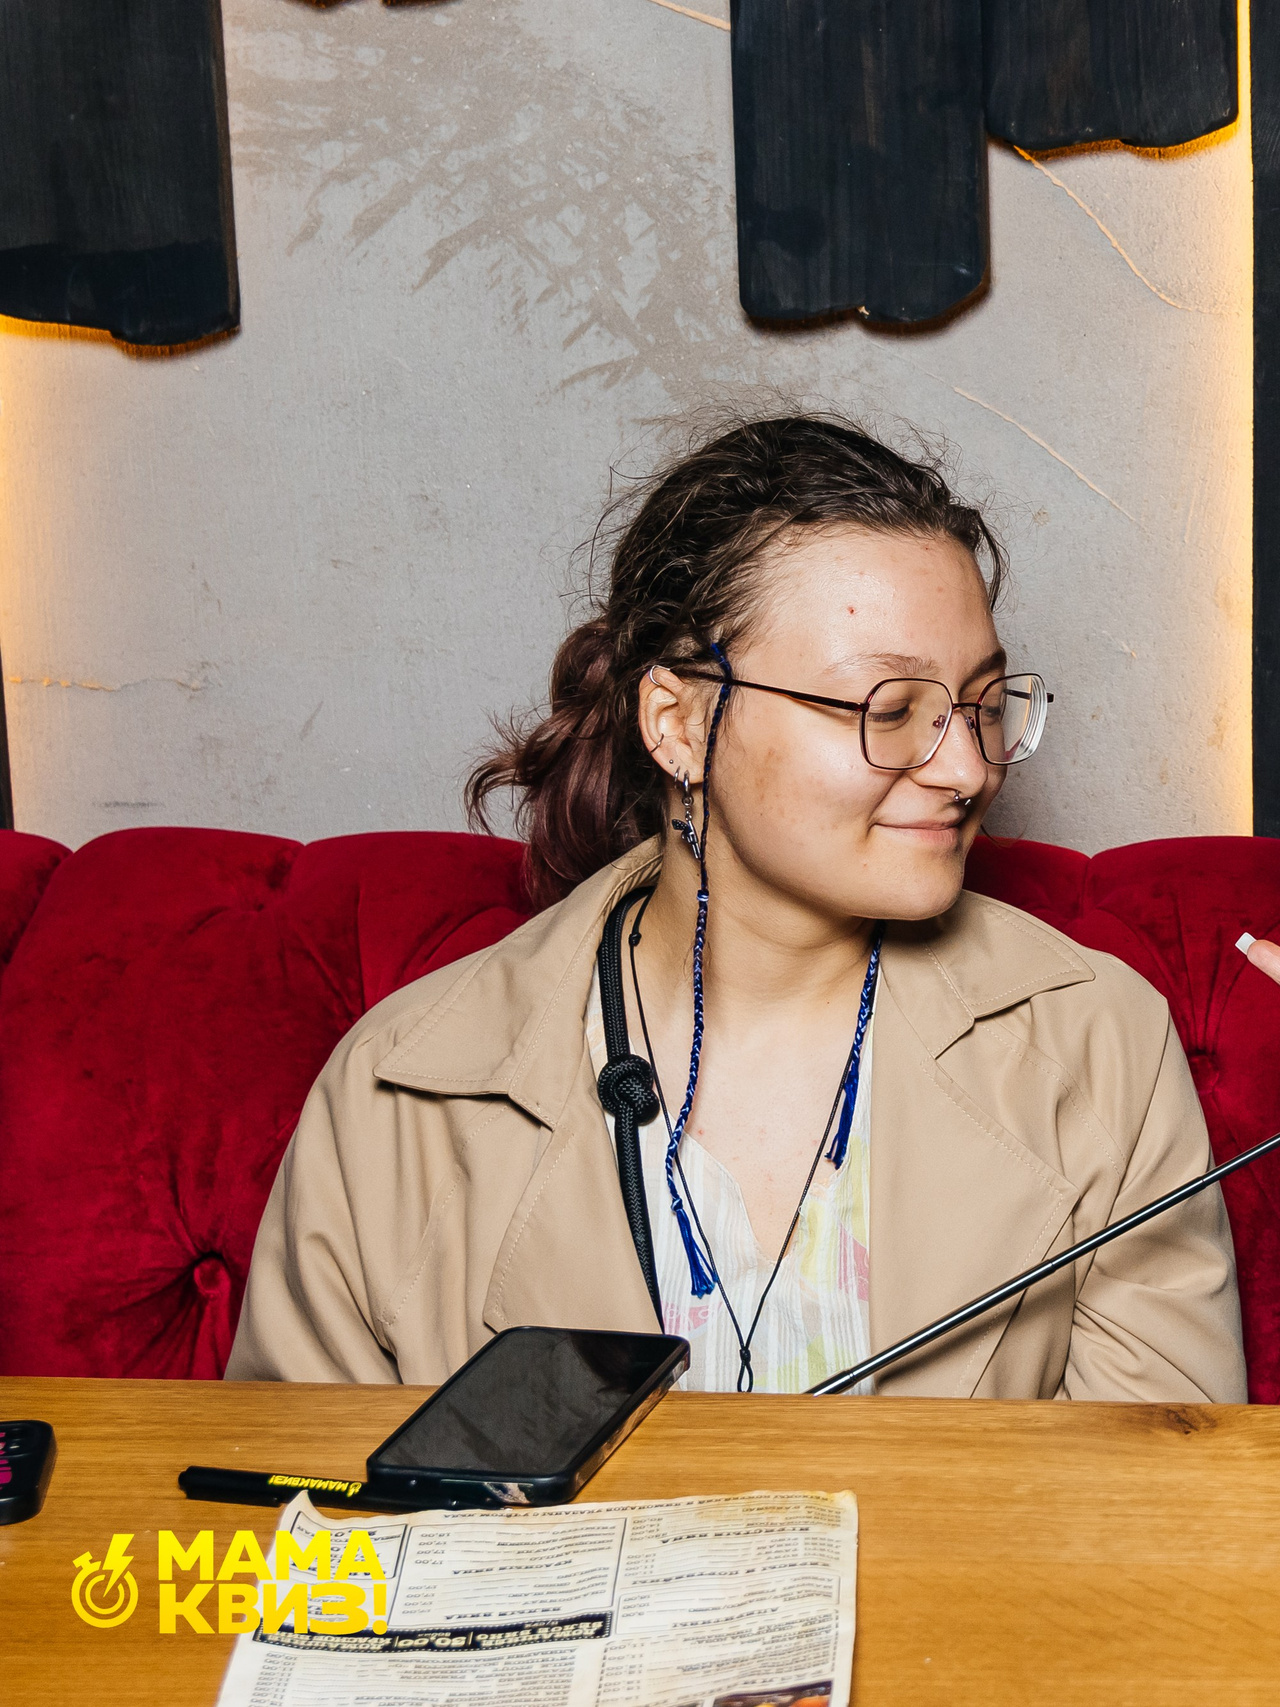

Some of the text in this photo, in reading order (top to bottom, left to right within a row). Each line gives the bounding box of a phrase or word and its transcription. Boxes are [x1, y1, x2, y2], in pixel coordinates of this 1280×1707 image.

[268, 1475, 349, 1491] МАМАКВИЗ!
[541, 1508, 602, 1517] УКАЗАНЫ
[475, 1621, 603, 1641] БЕЛОЕ ВИНО
[479, 1628, 596, 1647] ДОМАШНЕЕ
[266, 1634, 386, 1650] ДОМАШНЕЕ
